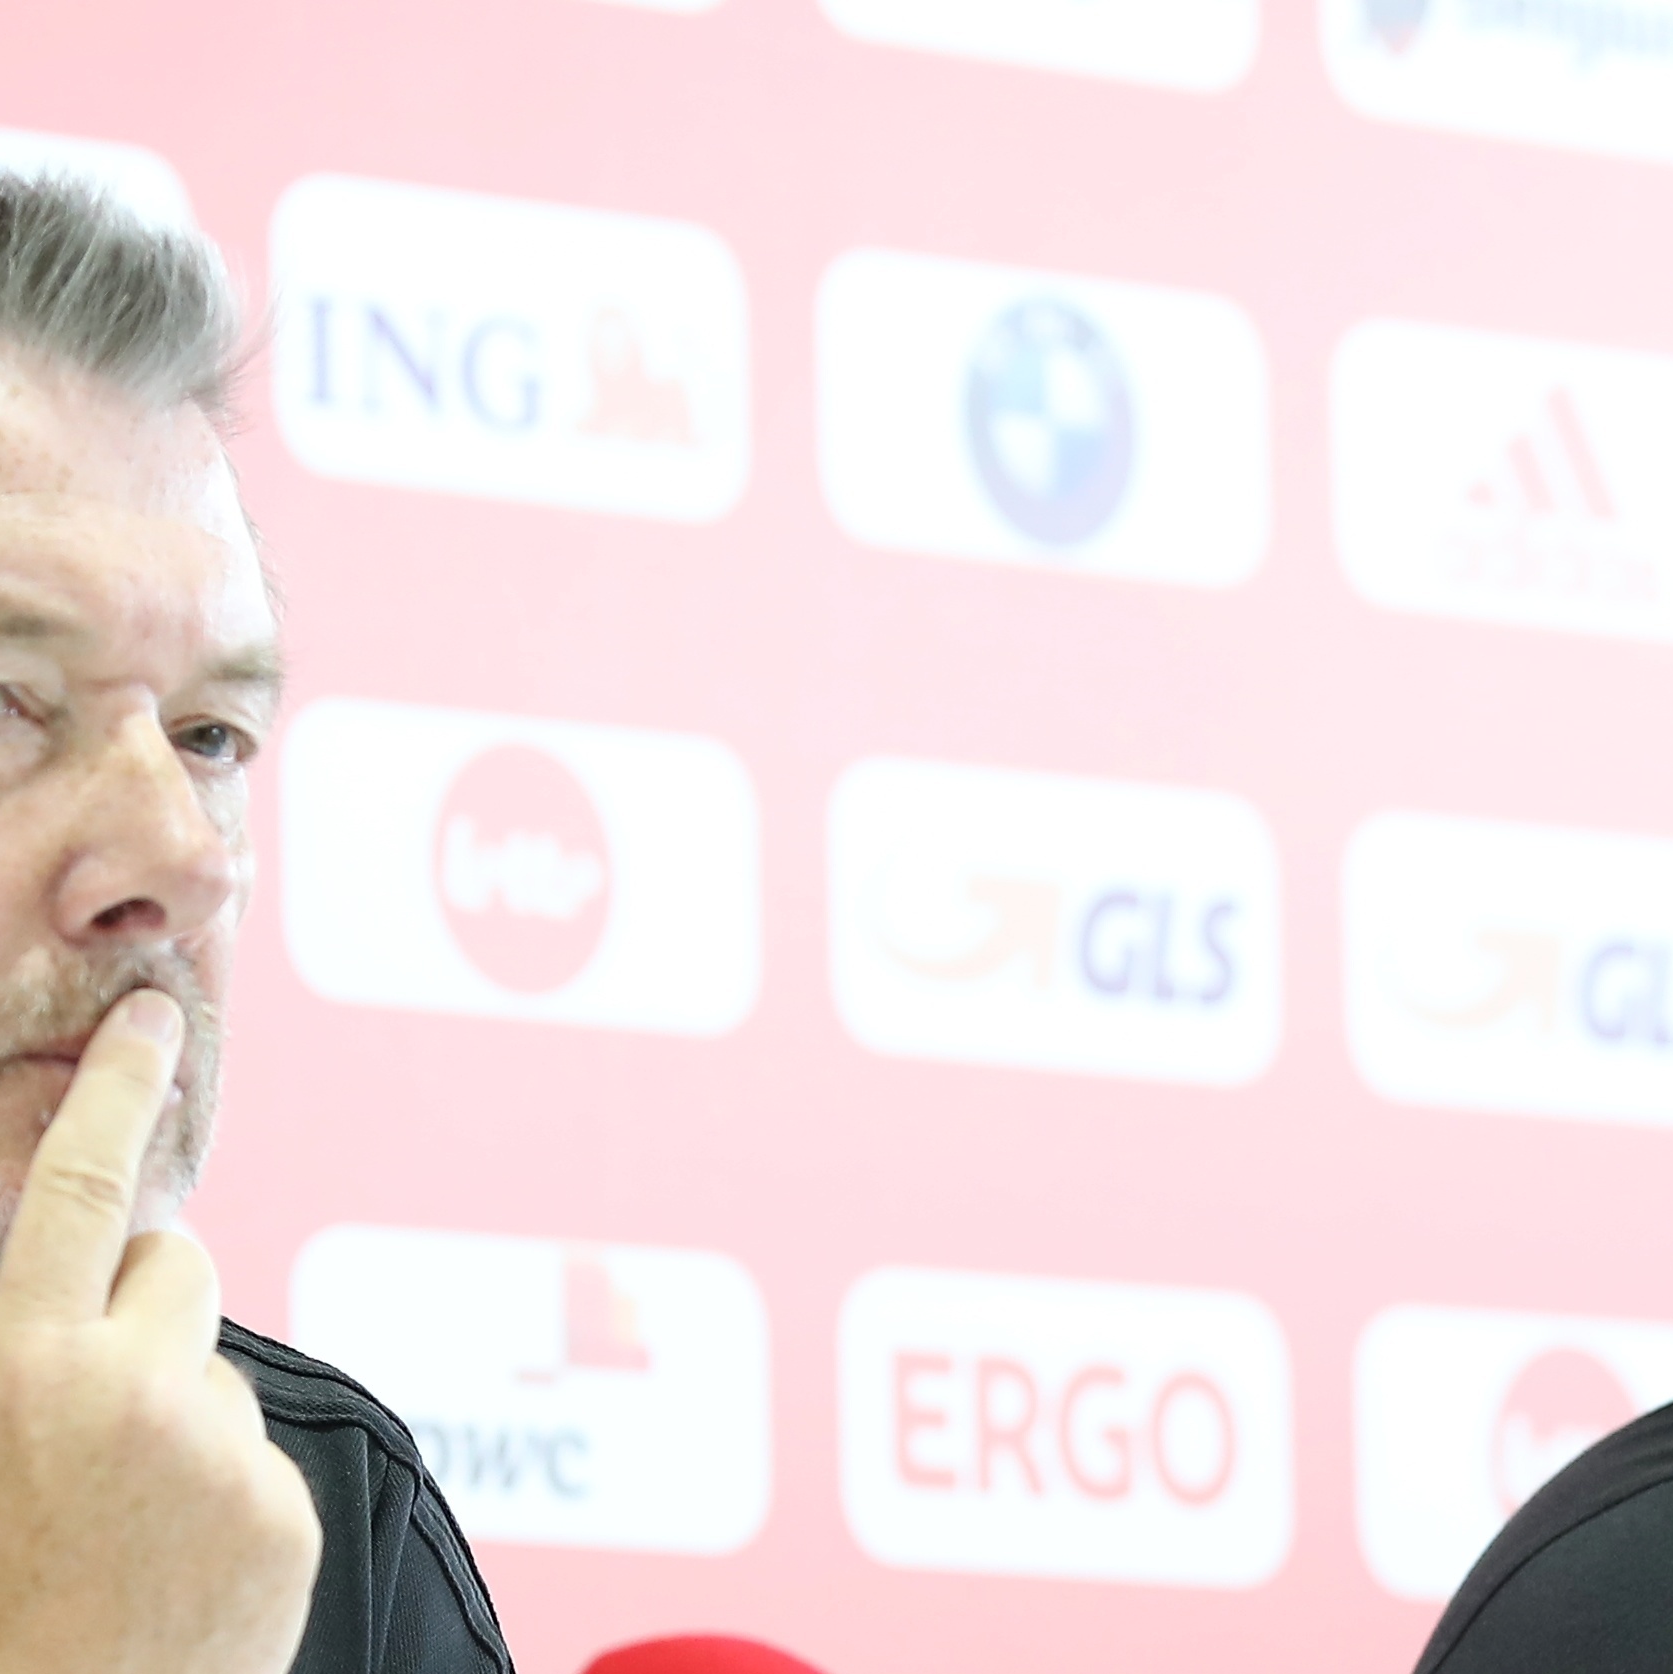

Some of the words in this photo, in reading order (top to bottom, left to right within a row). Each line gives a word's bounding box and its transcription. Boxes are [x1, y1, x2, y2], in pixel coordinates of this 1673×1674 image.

[306, 294, 543, 433] ING
[1079, 887, 1239, 1005] GLS
[893, 1349, 1238, 1507] ERGO
